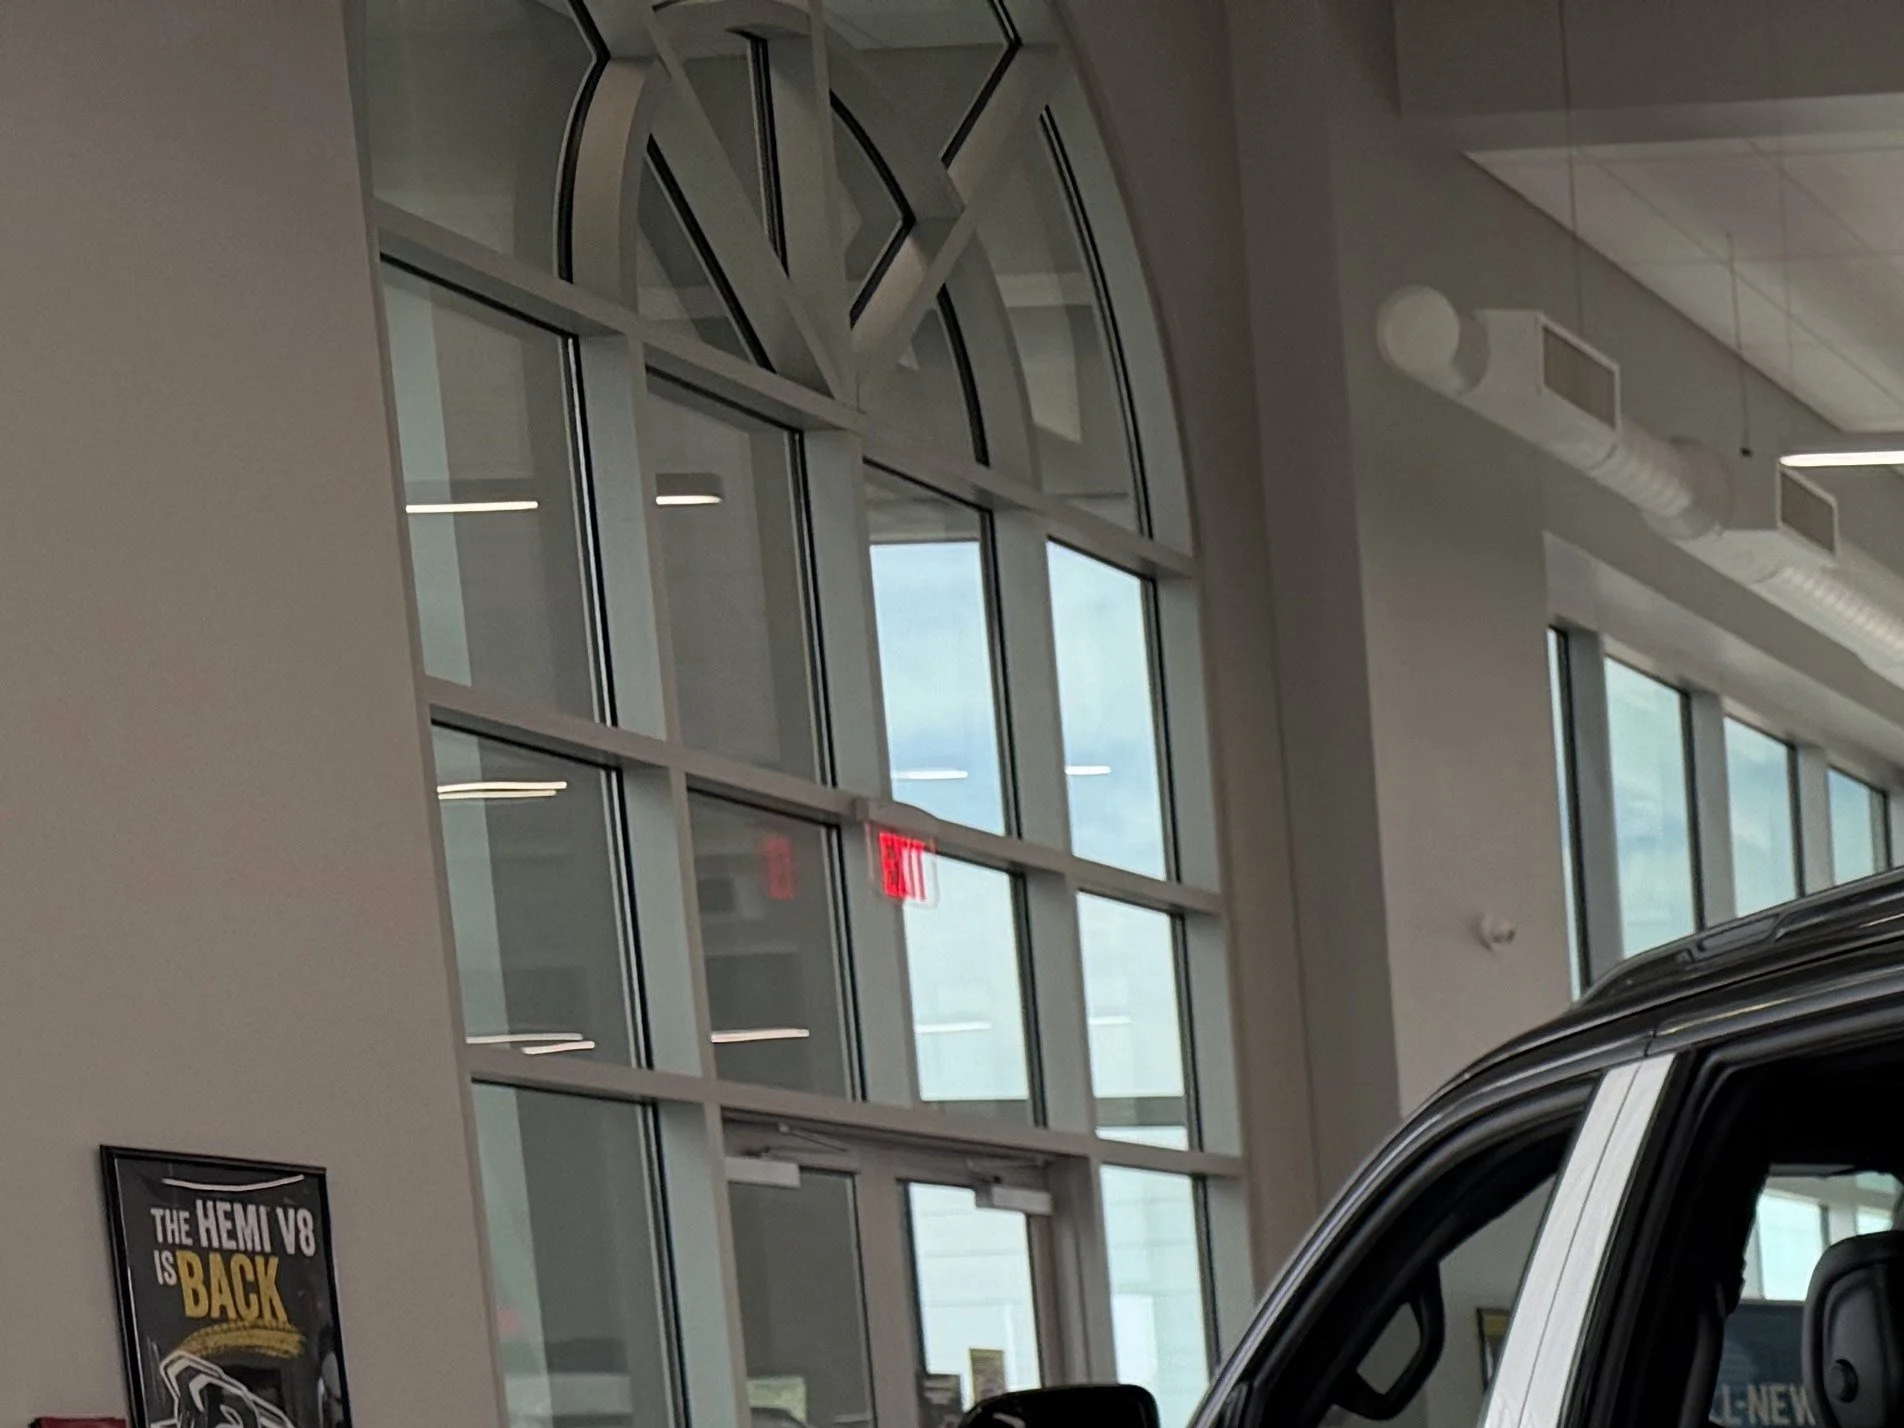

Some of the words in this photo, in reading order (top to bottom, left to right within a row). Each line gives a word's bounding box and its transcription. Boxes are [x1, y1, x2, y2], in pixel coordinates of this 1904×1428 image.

[150, 1207, 194, 1246] THE
[196, 1199, 272, 1253] HEMI
[275, 1206, 316, 1258] V8
[153, 1249, 178, 1286] IS
[176, 1249, 293, 1330] BACK
